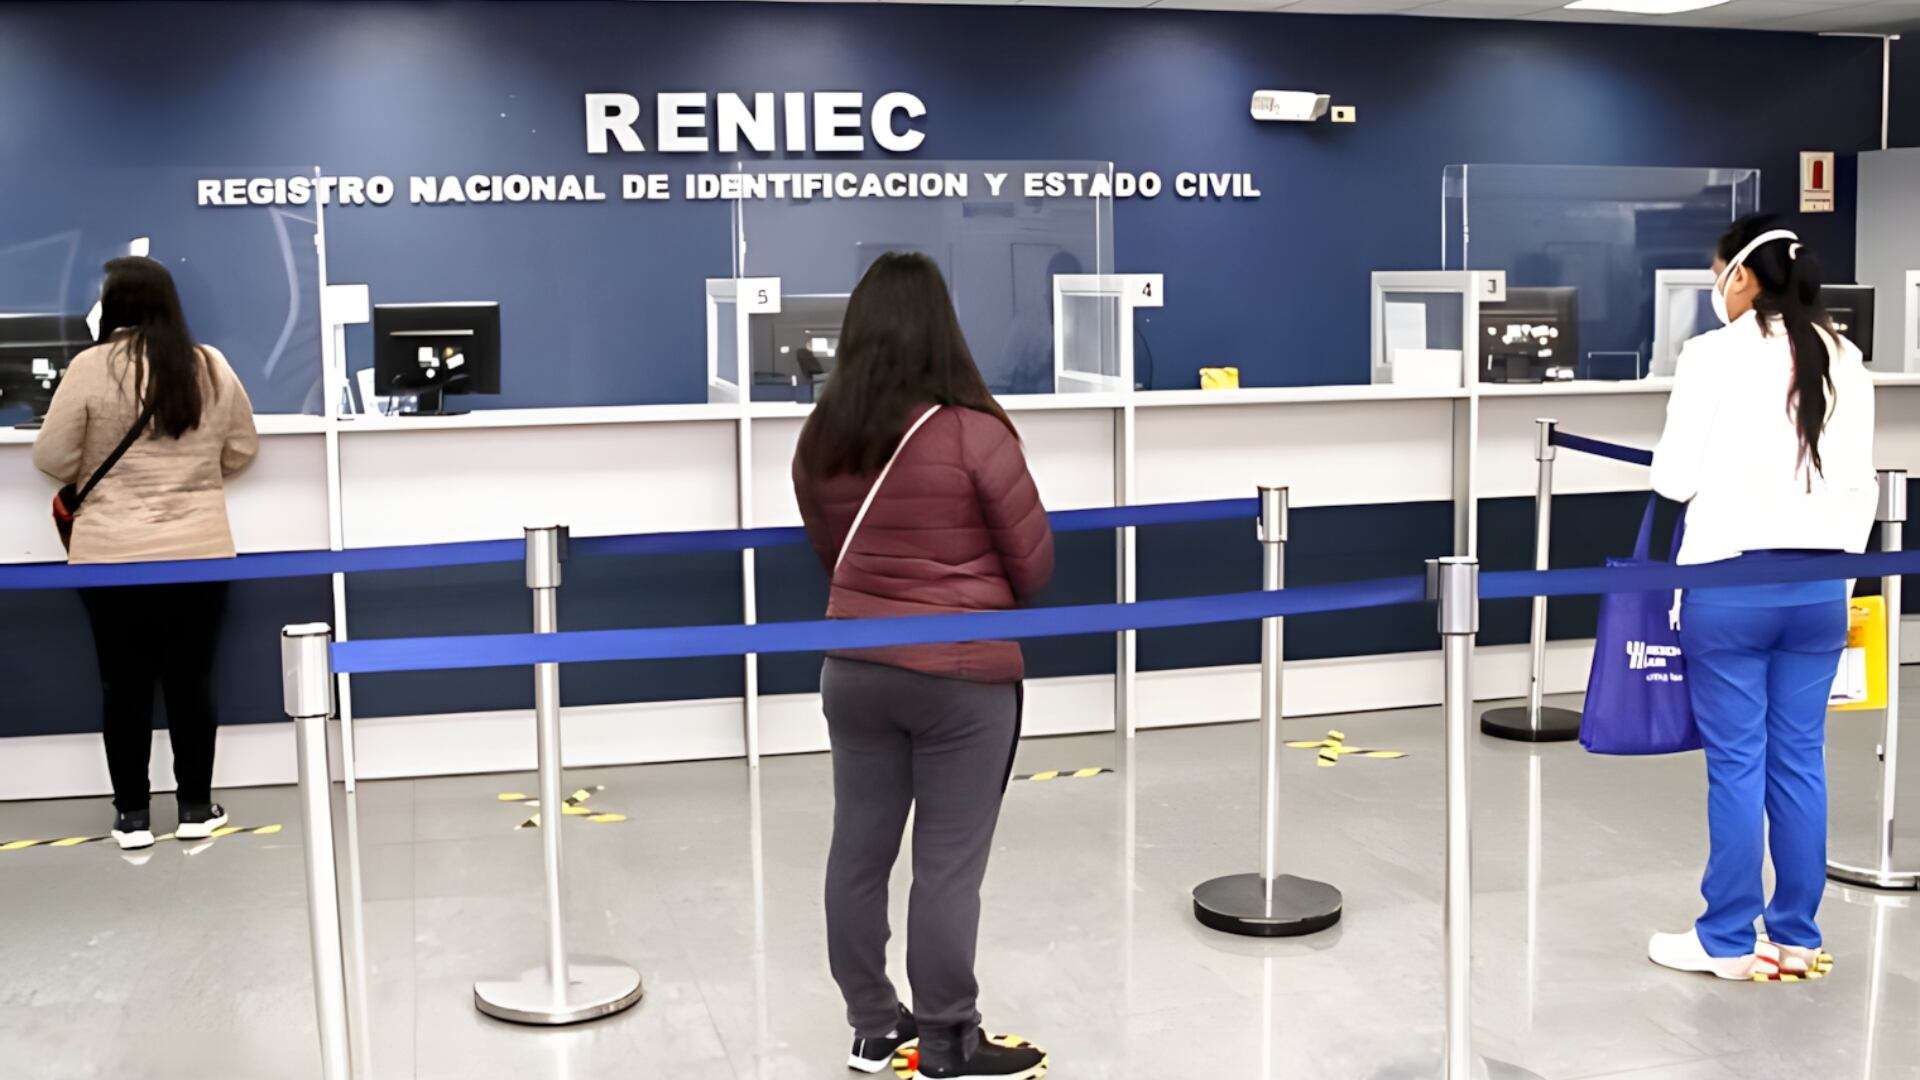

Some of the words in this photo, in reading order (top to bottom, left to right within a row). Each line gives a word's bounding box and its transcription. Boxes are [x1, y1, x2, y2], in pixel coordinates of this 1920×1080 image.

[585, 91, 927, 154] RENIEC
[198, 176, 394, 205] REGISTRO
[409, 173, 606, 202] NACIONAL
[622, 173, 671, 200] DE
[686, 171, 969, 201] IDENTIFICACION
[983, 171, 1009, 198] Y
[1024, 171, 1162, 199] ESTADO
[1175, 171, 1262, 198] CIVIL
[757, 289, 768, 305] 5
